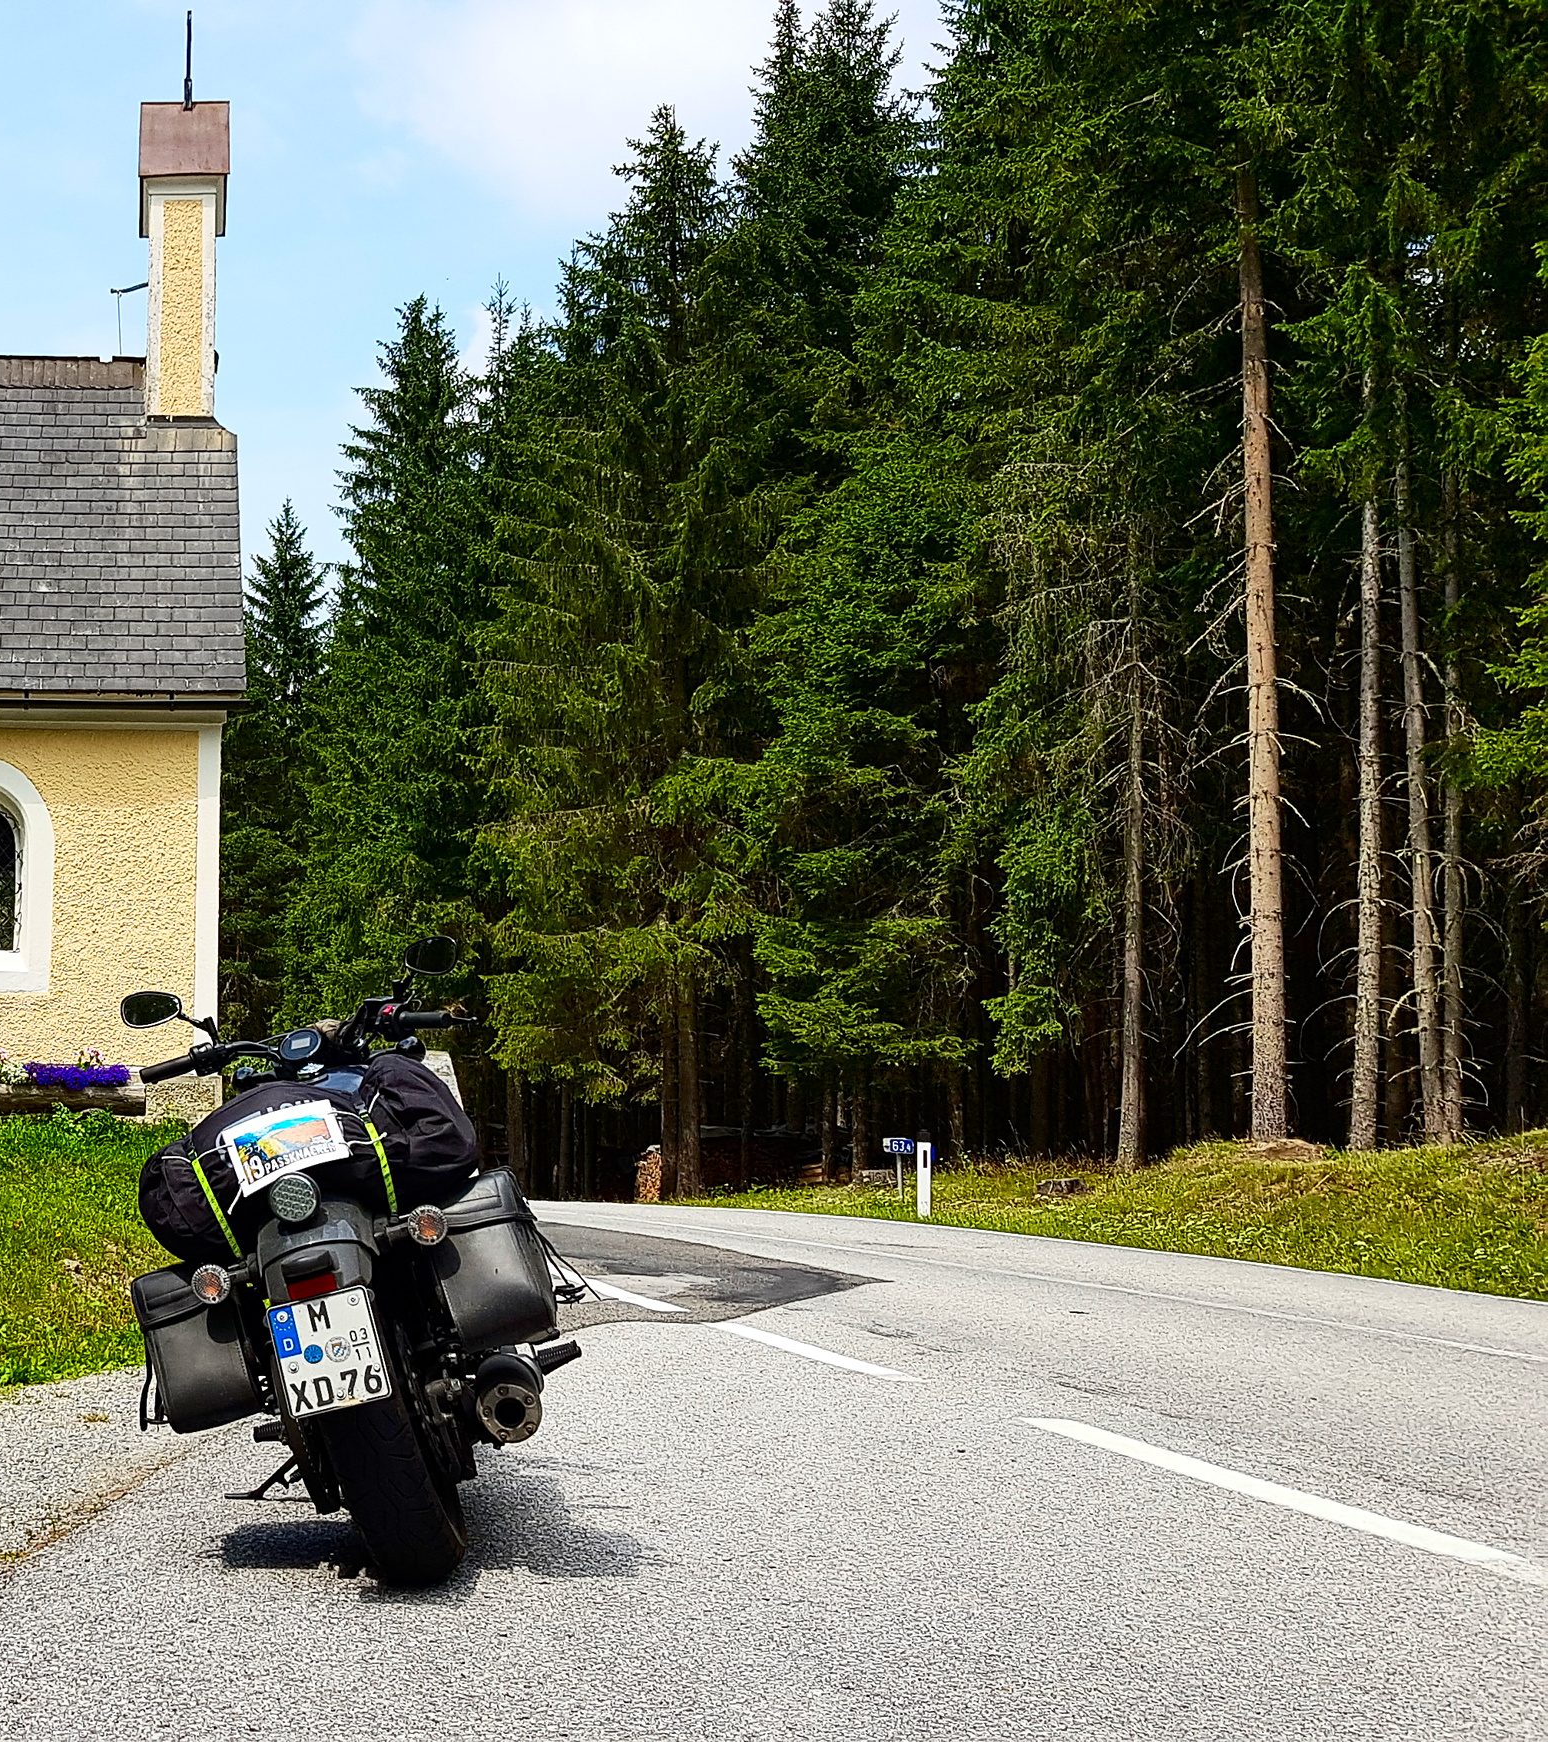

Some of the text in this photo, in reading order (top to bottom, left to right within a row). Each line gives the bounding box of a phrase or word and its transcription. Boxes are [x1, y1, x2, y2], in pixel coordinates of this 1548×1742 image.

[243, 1155, 265, 1184] 19
[307, 1300, 331, 1332] M
[283, 1338, 294, 1352] D
[349, 1328, 368, 1342] 03
